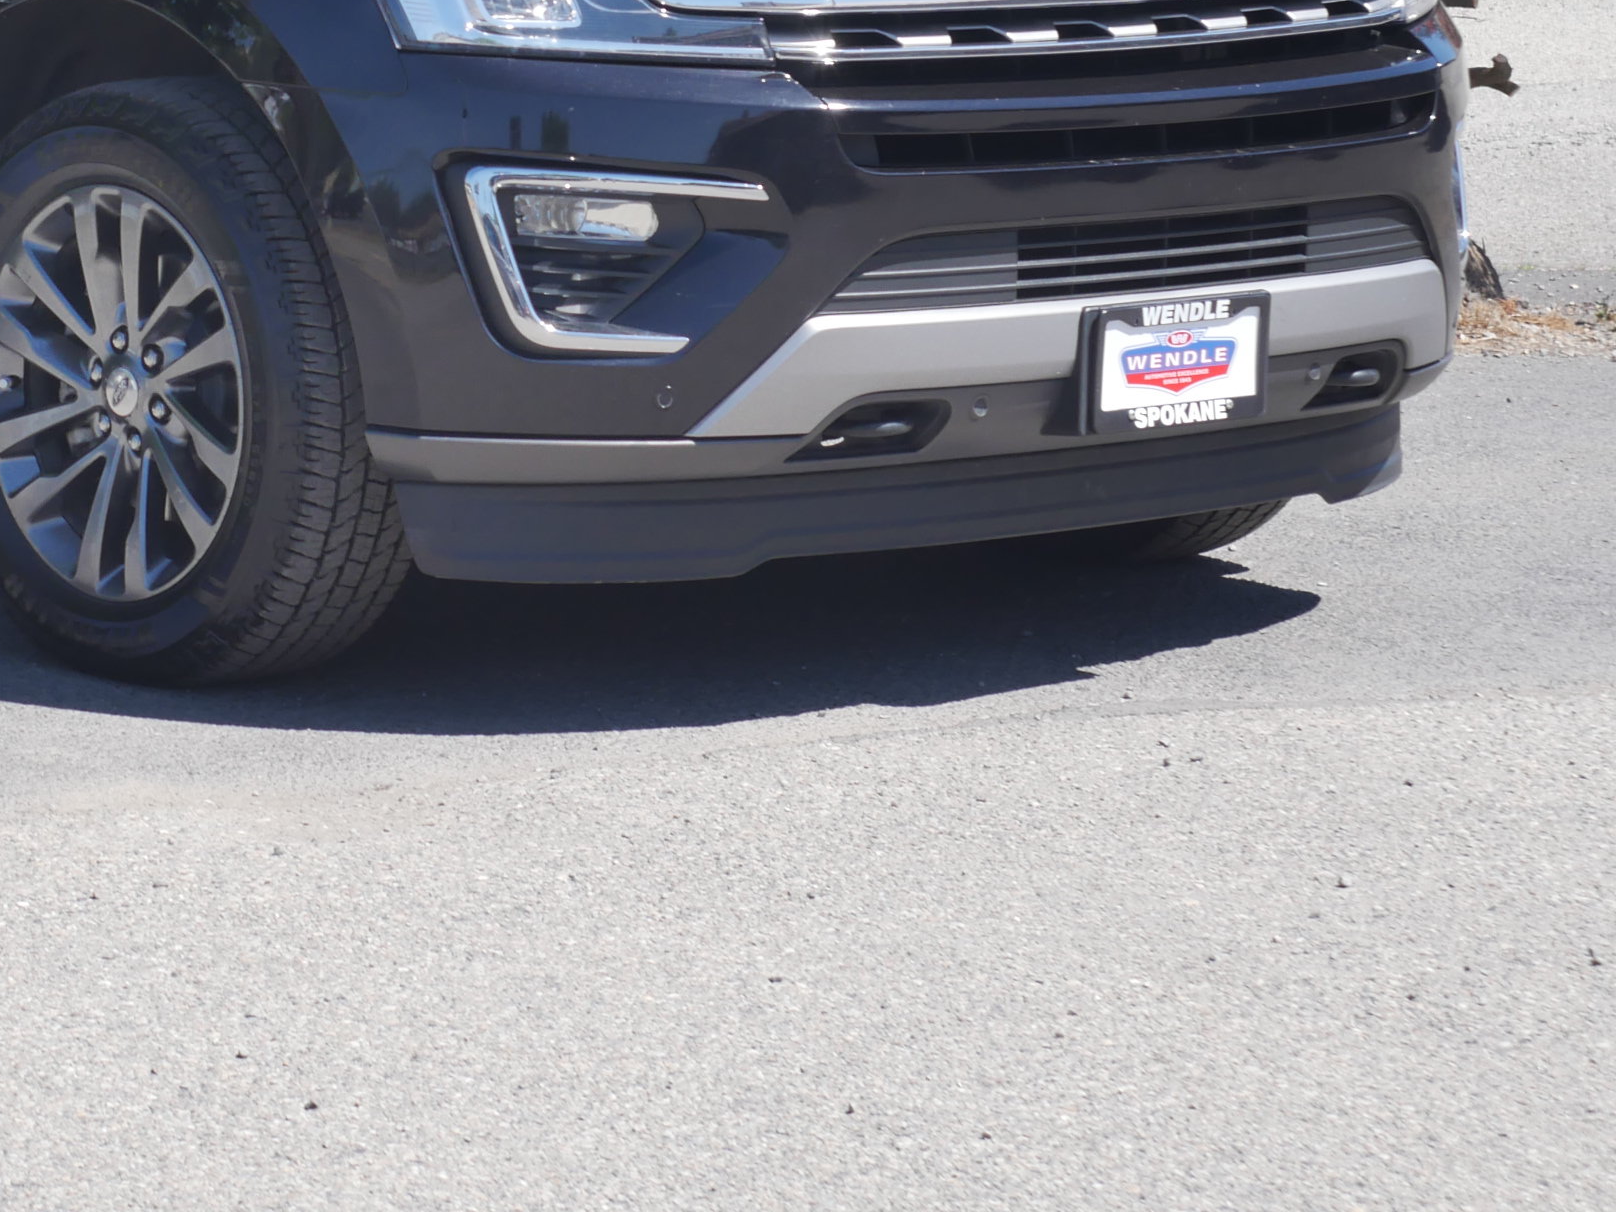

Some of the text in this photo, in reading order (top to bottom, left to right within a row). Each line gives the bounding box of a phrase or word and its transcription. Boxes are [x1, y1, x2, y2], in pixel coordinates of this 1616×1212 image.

[1142, 299, 1231, 327] WENDLE
[1126, 347, 1228, 371] WENDLE
[1133, 398, 1229, 429] SPOKANE
